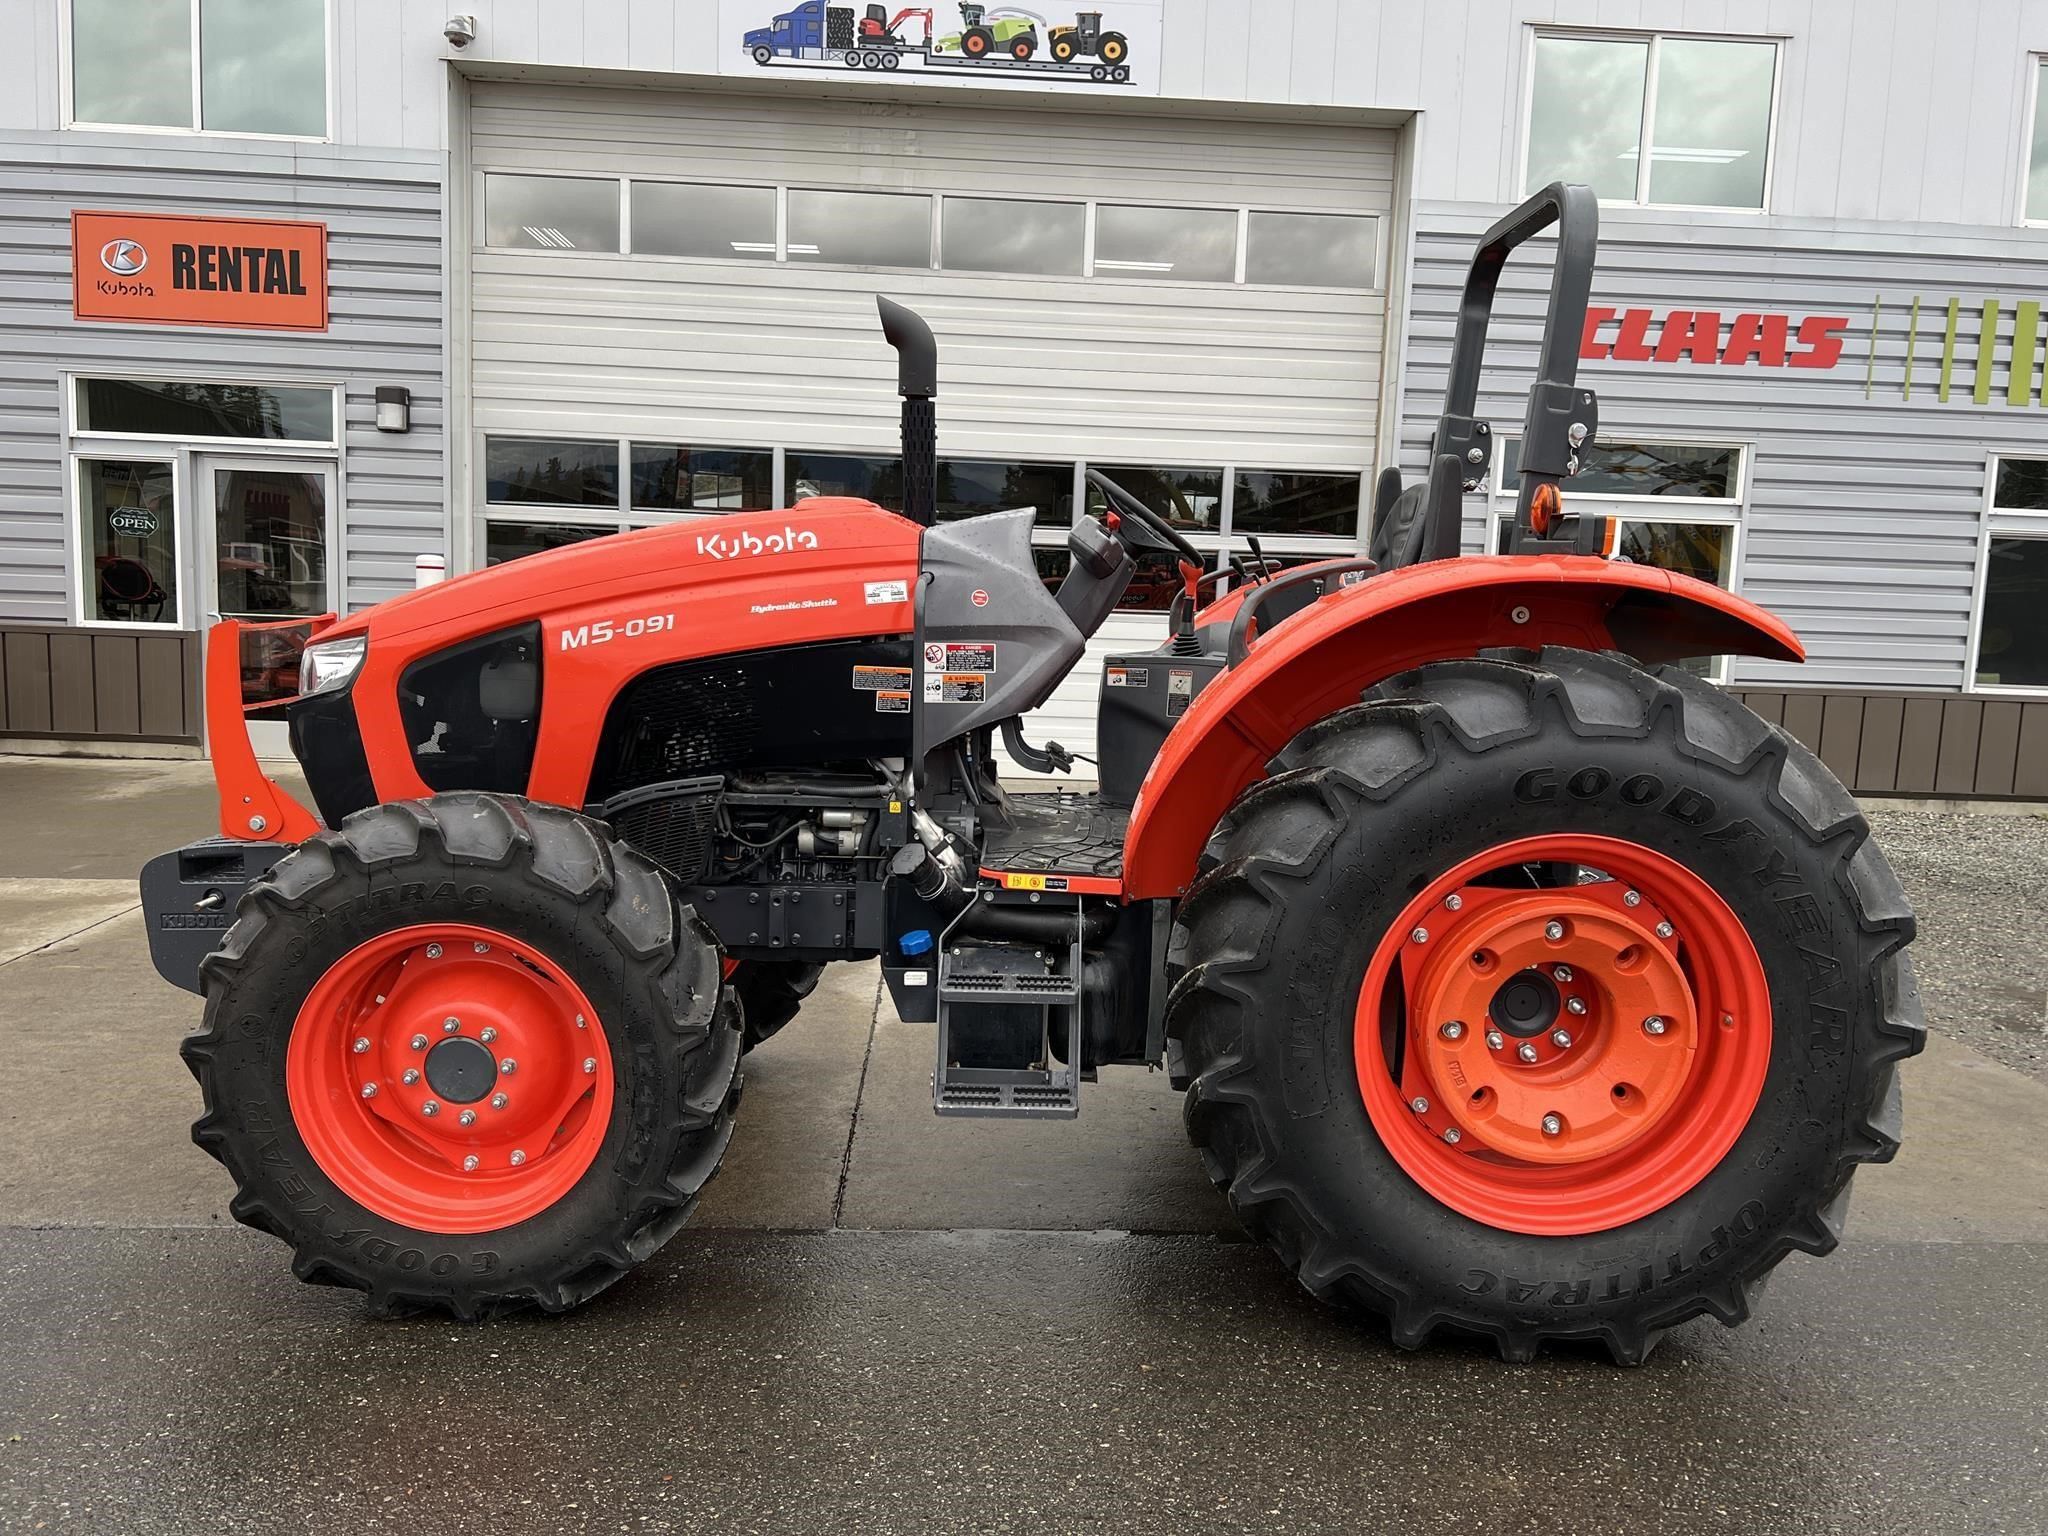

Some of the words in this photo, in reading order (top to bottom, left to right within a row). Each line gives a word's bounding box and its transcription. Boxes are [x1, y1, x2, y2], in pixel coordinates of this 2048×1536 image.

[97, 280, 154, 297] Kubota
[172, 244, 307, 296] RENTAL
[1579, 307, 1849, 369] CLAAS
[112, 517, 156, 530] OPEN
[696, 526, 818, 560] Kubota
[751, 602, 800, 613] Hydraulic
[801, 598, 838, 608] Shuttle
[561, 613, 675, 651] M5-091
[161, 914, 228, 928] KUBOTA
[1512, 766, 1849, 1073] GOODYEAR
[247, 1100, 501, 1278] GOODYEAR
[1456, 1199, 1767, 1308] OPTITRAC
